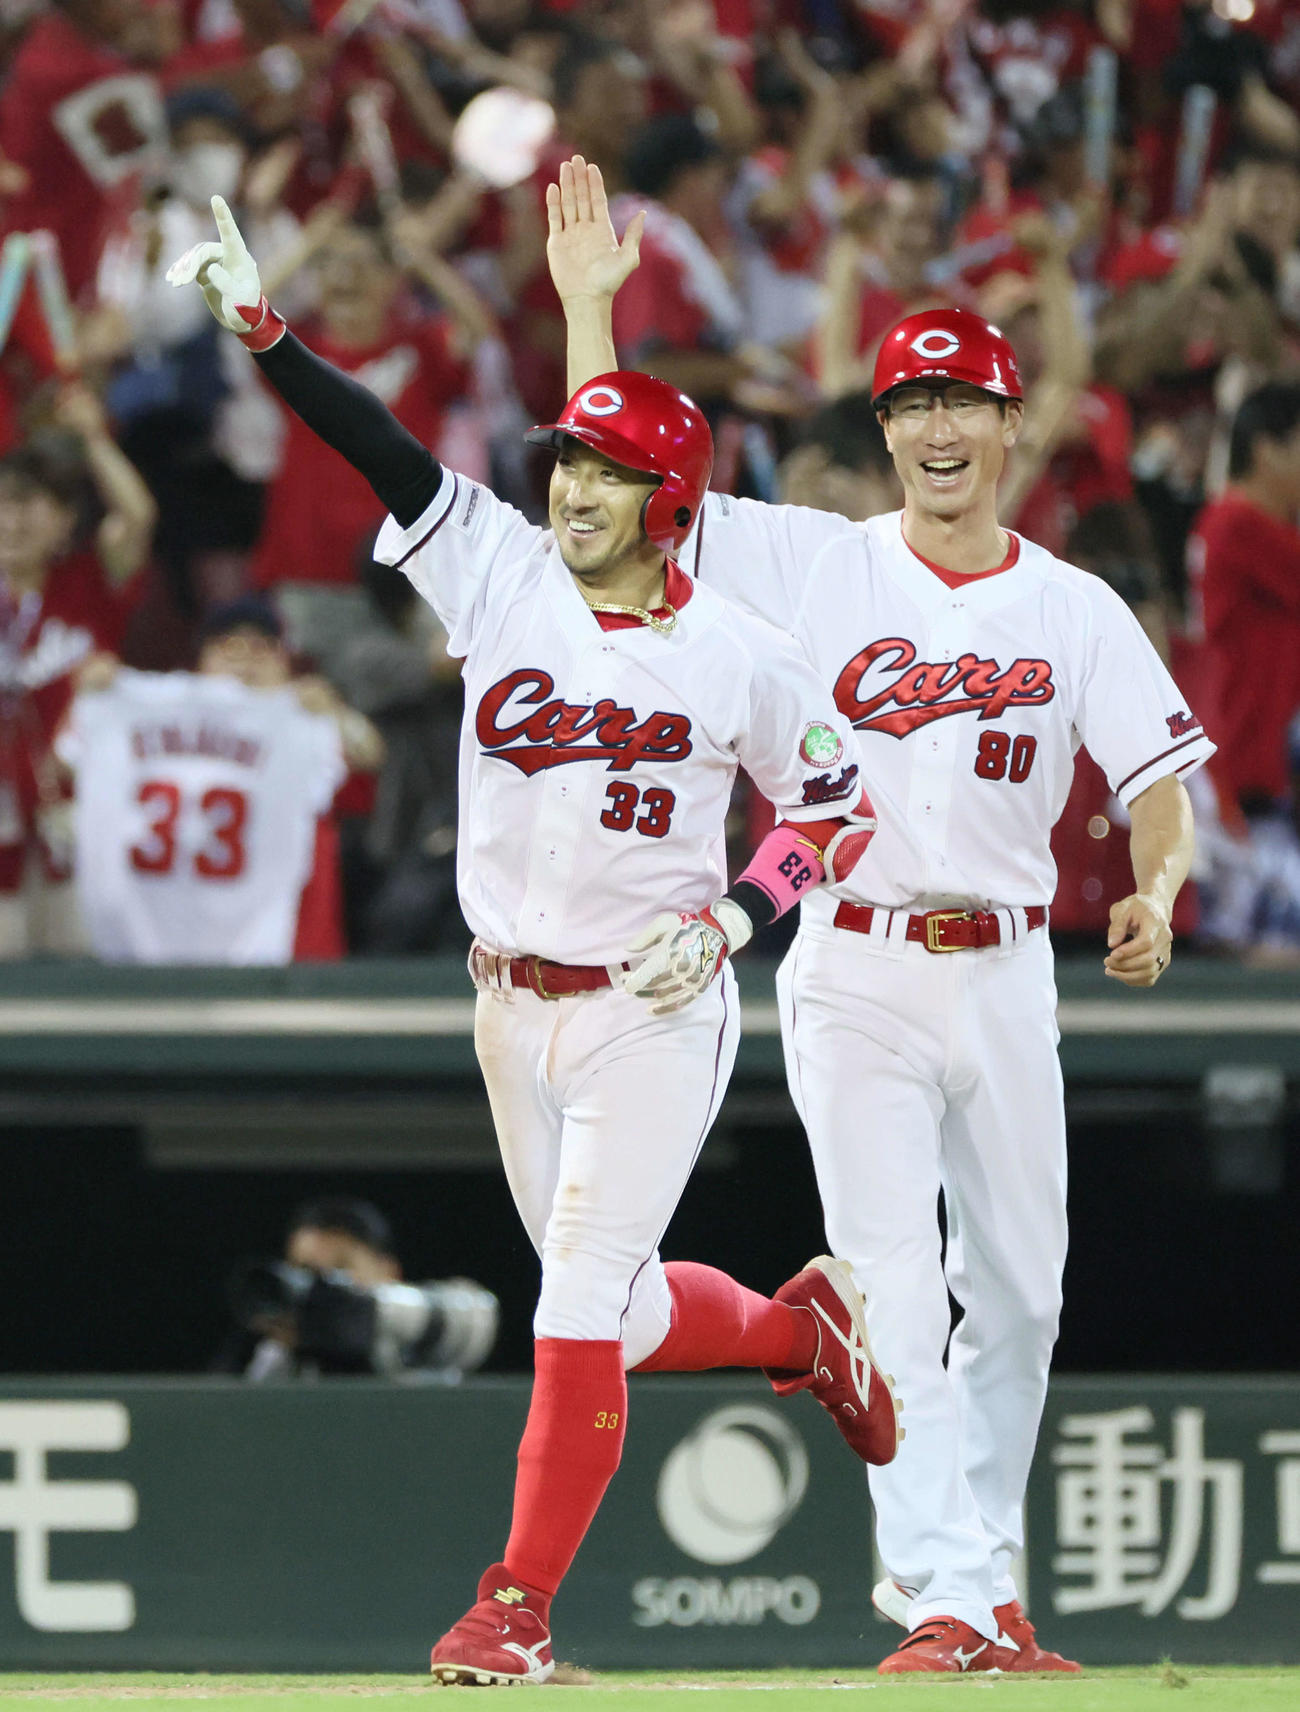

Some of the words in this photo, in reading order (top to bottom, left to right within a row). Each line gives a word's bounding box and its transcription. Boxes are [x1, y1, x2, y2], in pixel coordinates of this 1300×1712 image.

[833, 637, 1055, 738] Carp
[475, 668, 693, 776] Carp
[974, 730, 1038, 783] 80
[130, 780, 247, 876] 33
[600, 780, 676, 838] 33
[778, 851, 812, 892] 33
[594, 1411, 619, 1429] 33
[632, 1575, 821, 1626] SOMPO
